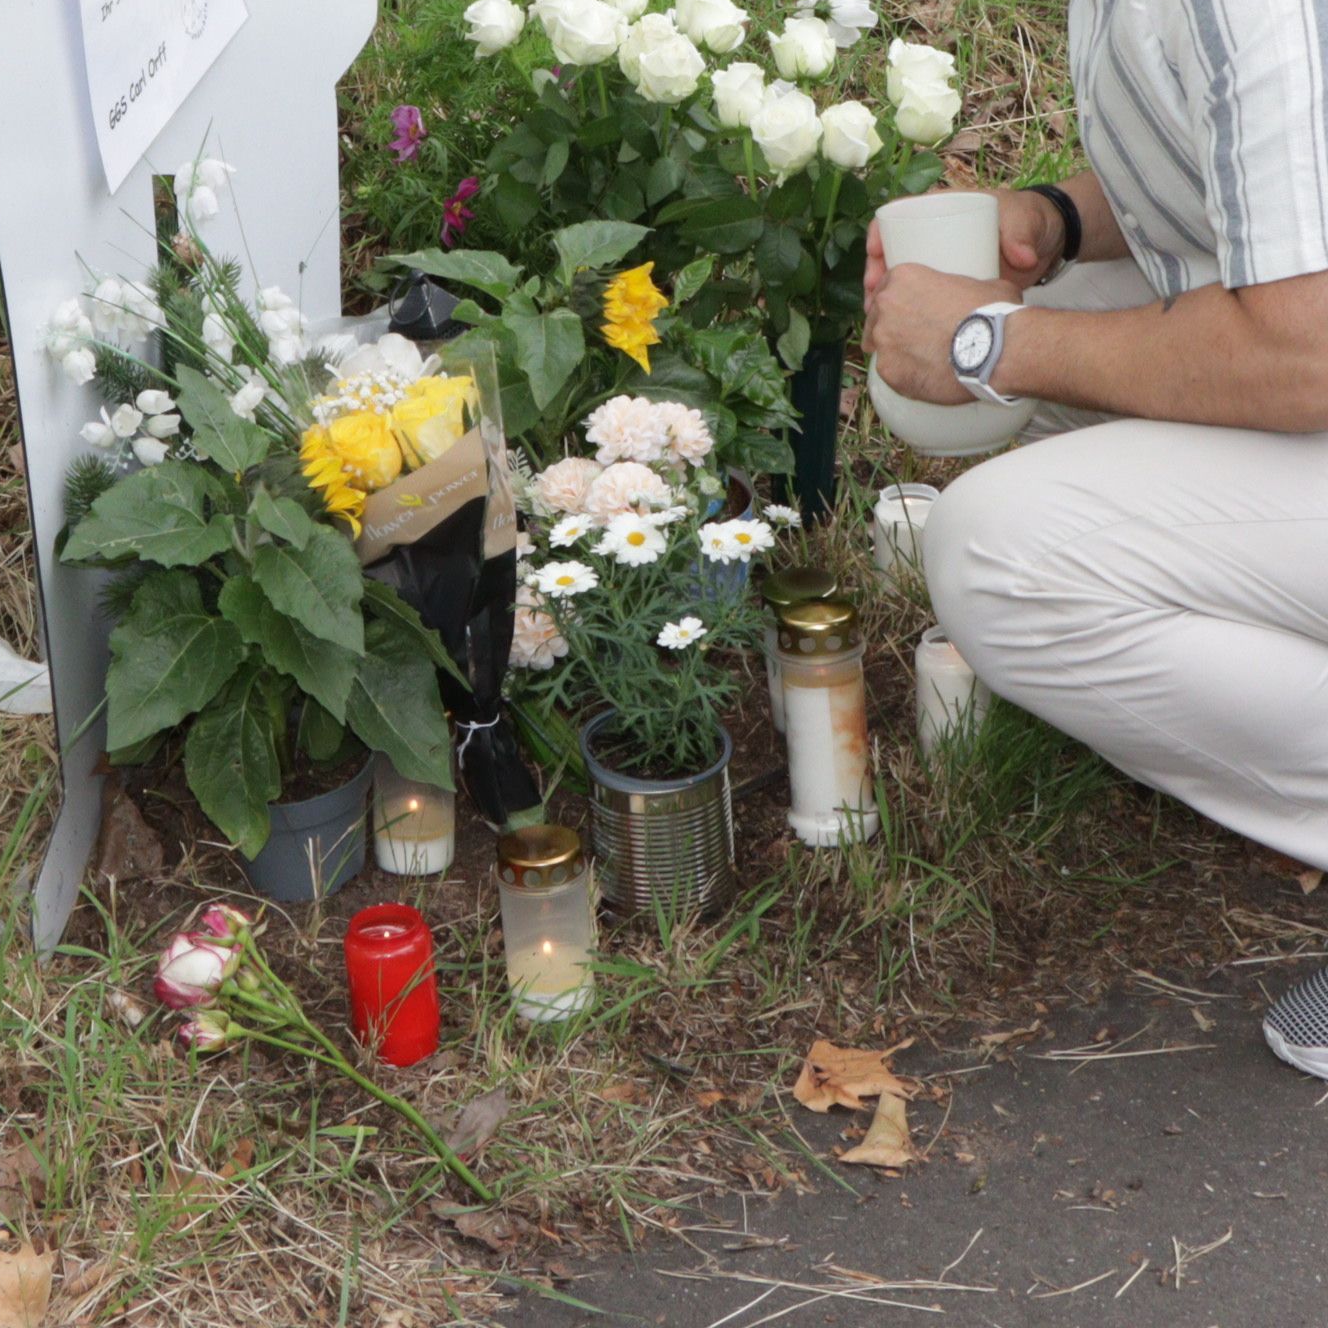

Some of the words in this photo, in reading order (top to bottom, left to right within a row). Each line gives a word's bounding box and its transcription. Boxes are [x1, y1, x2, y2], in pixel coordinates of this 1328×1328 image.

[100, 0, 114, 23] Ihr
[108, 94, 128, 130] GGS
[129, 67, 147, 103] Carl
[148, 40, 167, 79] Orff
[364, 509, 416, 541] flower
[427, 468, 479, 505] power
